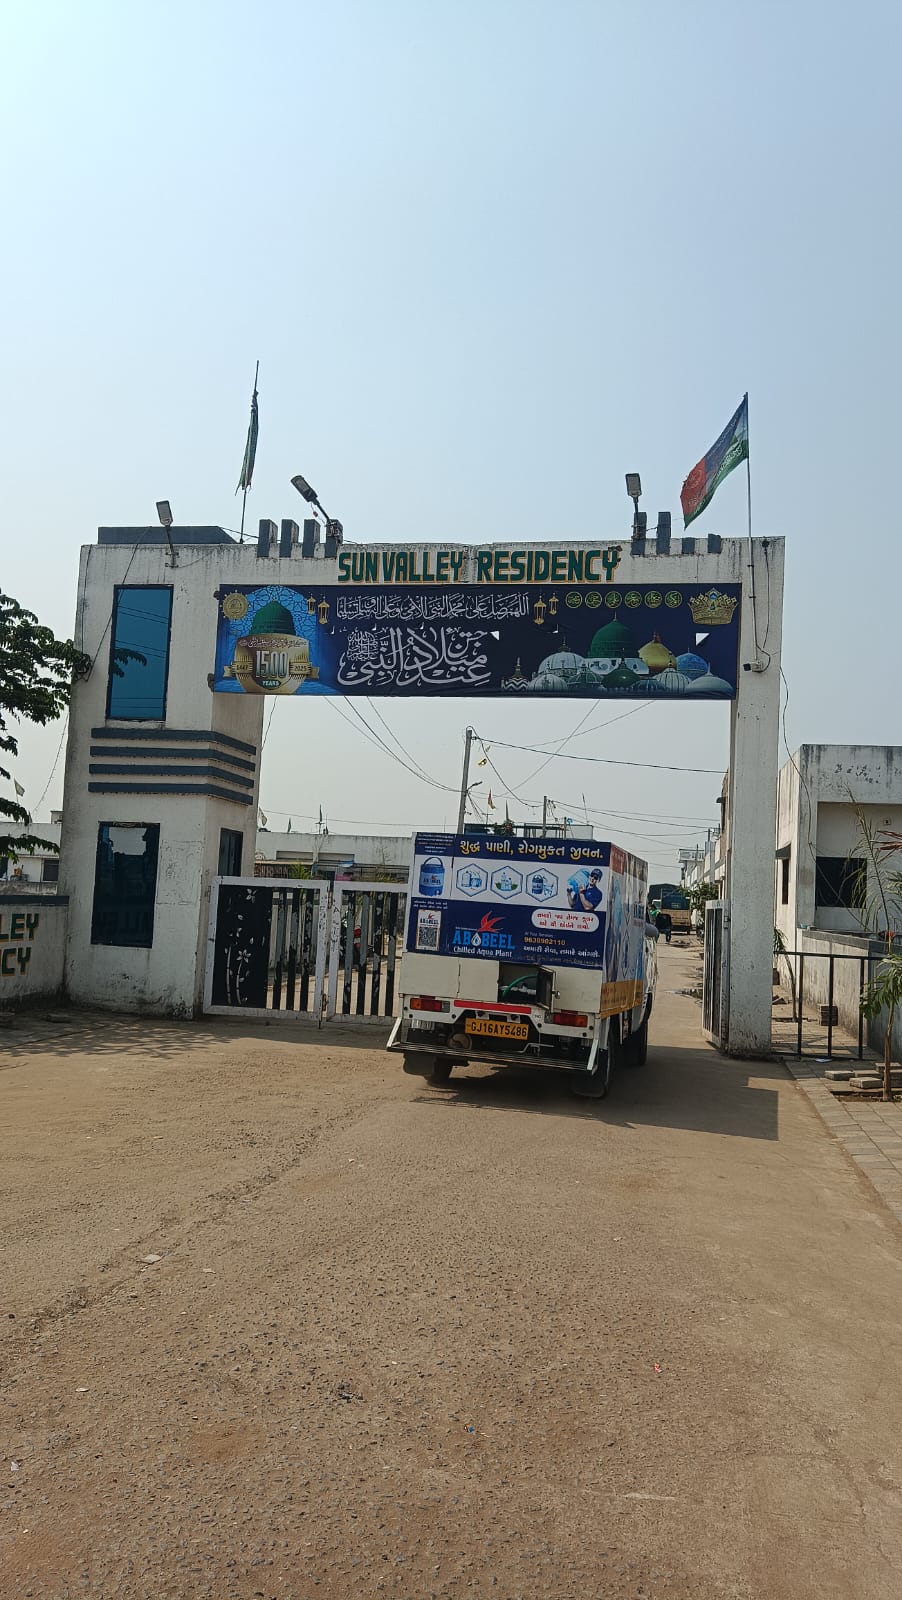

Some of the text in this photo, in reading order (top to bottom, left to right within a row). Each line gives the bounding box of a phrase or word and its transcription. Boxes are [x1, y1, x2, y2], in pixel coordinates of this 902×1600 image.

[382, 551, 464, 583] VALLEY
[477, 550, 618, 582] RESIDENCY
[255, 650, 289, 678] 1500
[486, 839, 514, 856] પાણી,
[0, 946, 31, 976] CY
[453, 945, 512, 958] Chilled Aqua Plant
[471, 1021, 527, 1037] GJ16AY5486
